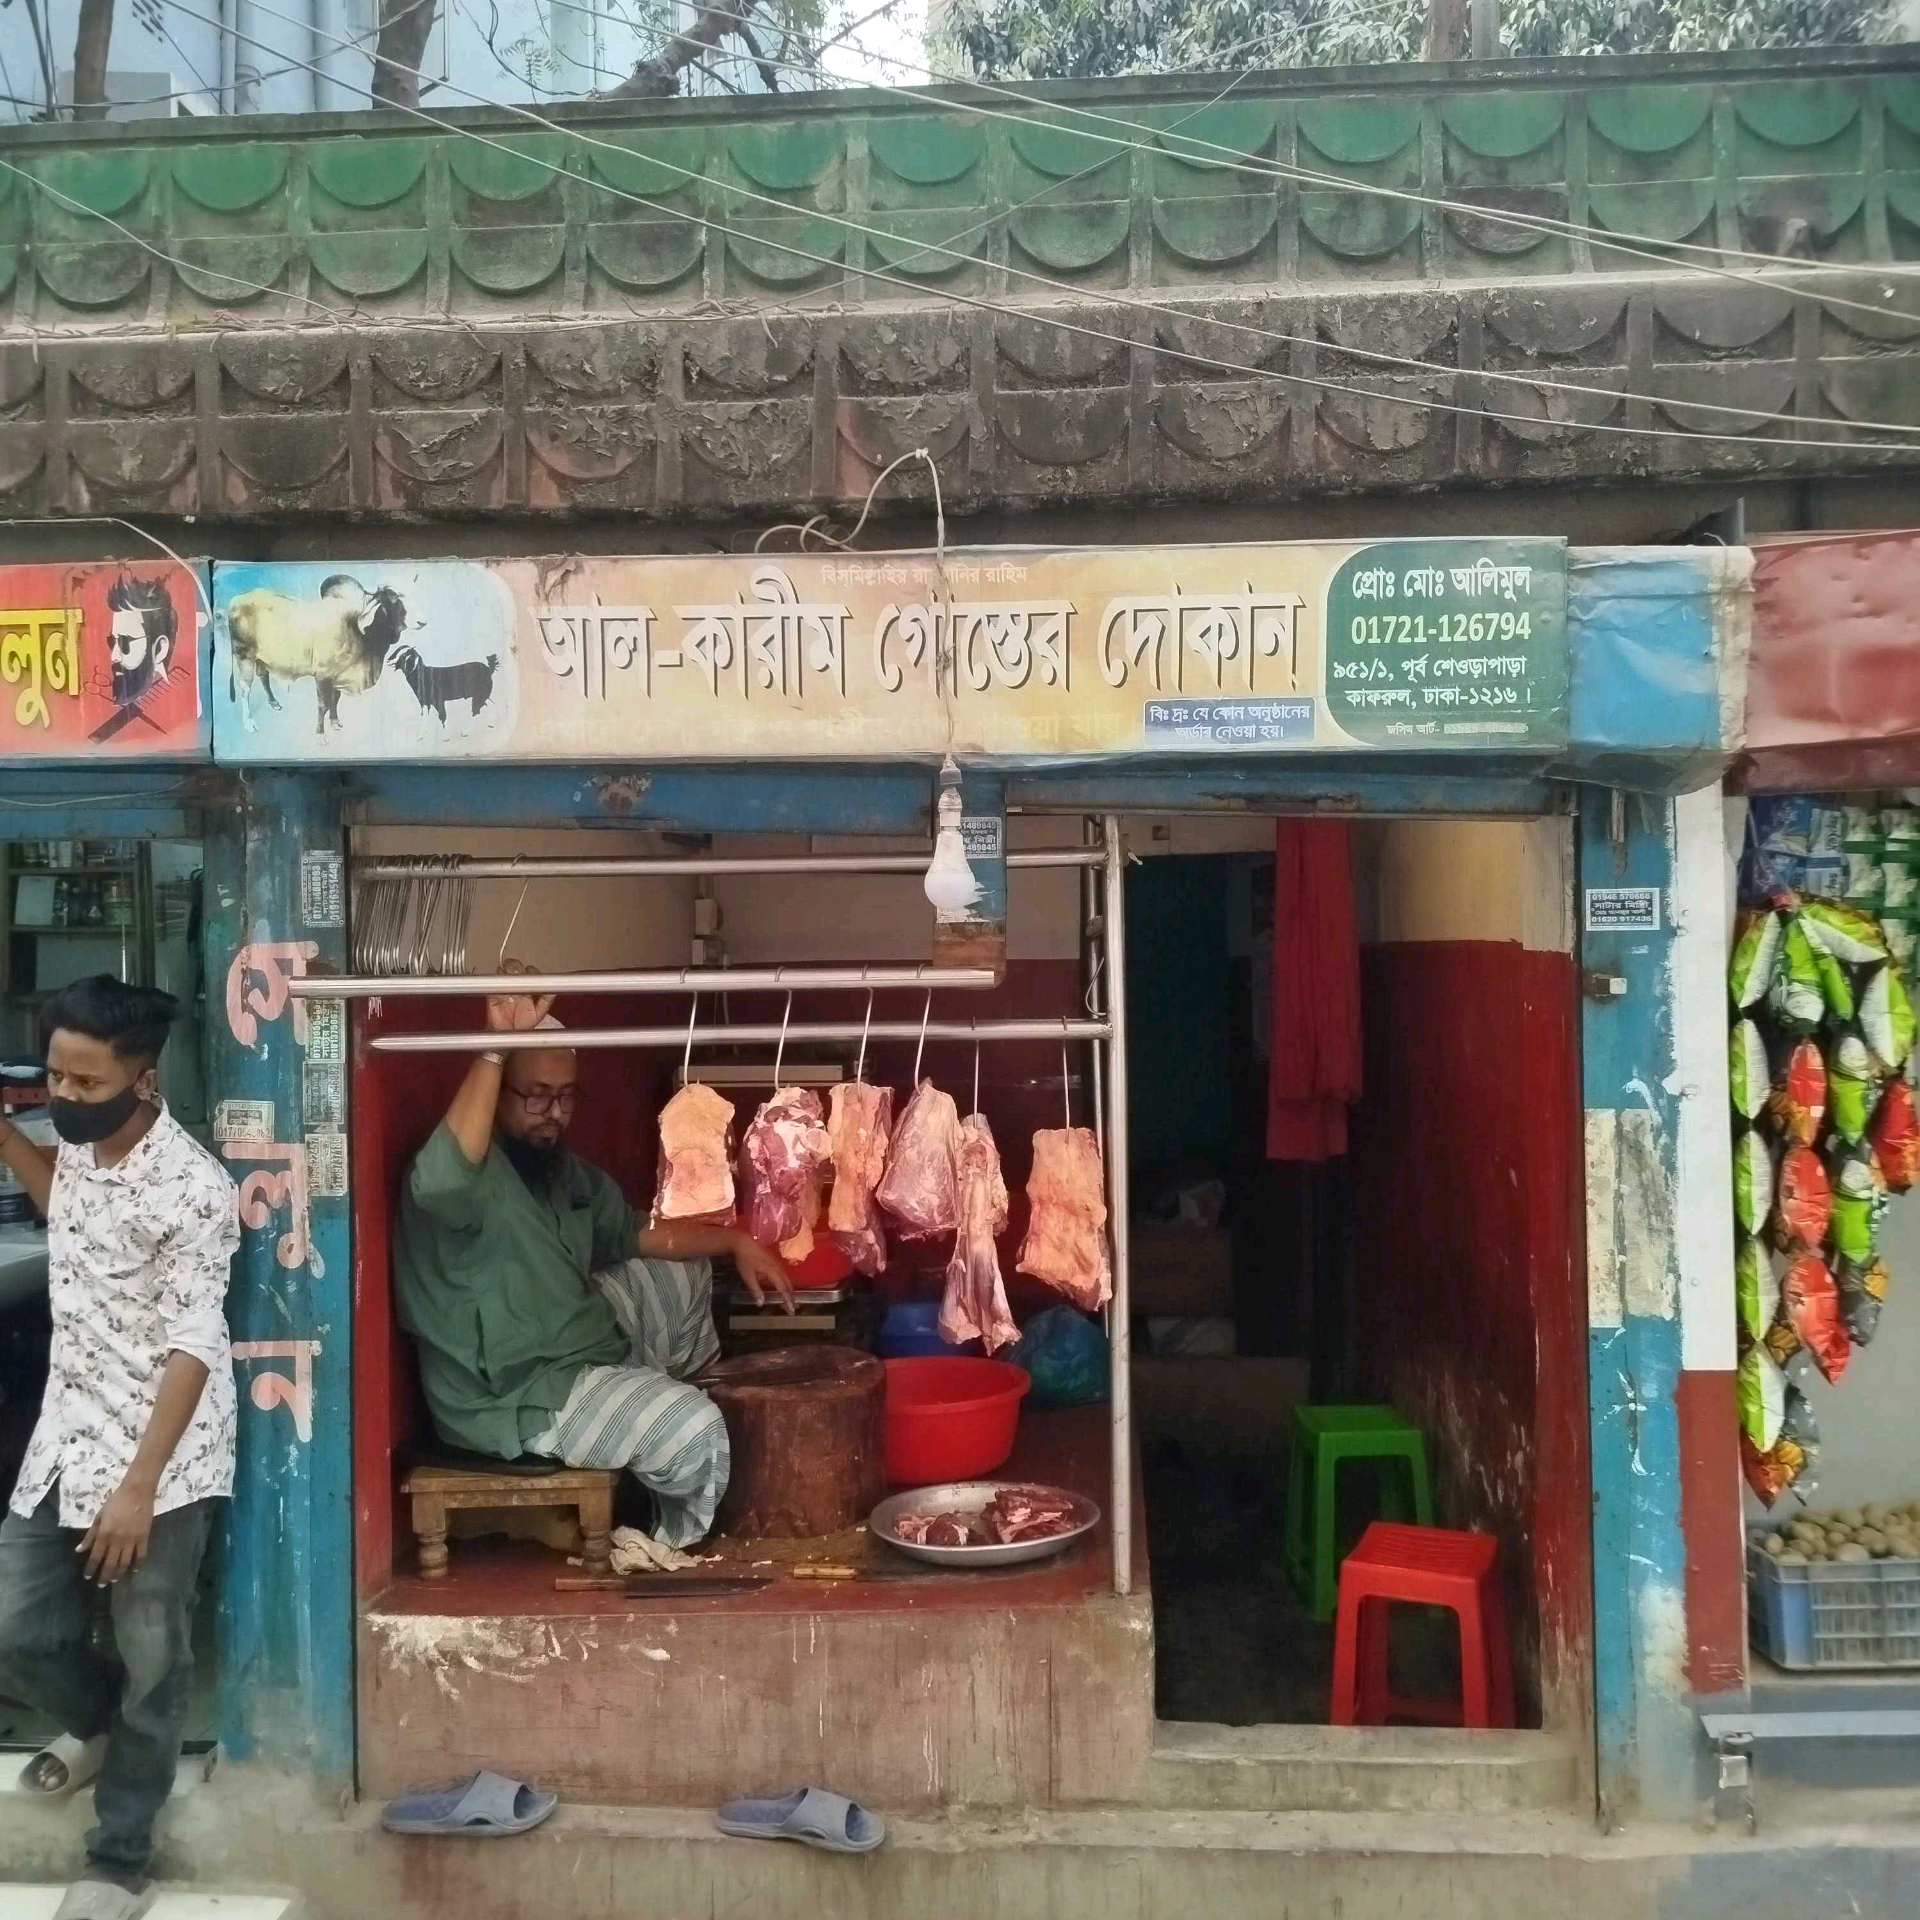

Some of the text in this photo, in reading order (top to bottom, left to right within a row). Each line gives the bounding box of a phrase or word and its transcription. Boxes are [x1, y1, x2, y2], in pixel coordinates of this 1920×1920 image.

[1352, 557, 1533, 602] প্রোঃ মোঃ আলিমুল
[527, 565, 1307, 700] আল-কারীম গোস্তের দোকান
[1351, 612, 1532, 645] 01721-126794
[1333, 653, 1528, 683] ৯৫১/১, পূর্ব শেওড়াপাড়া
[1421, 685, 1518, 707] ঢাকা-১২১৬
[1150, 702, 1311, 723] বিঃ দ্রঃ যে কোন অনুষ্ঠানের
[1174, 723, 1212, 739] অর্ডার
[1215, 724, 1256, 739] নেওয়া
